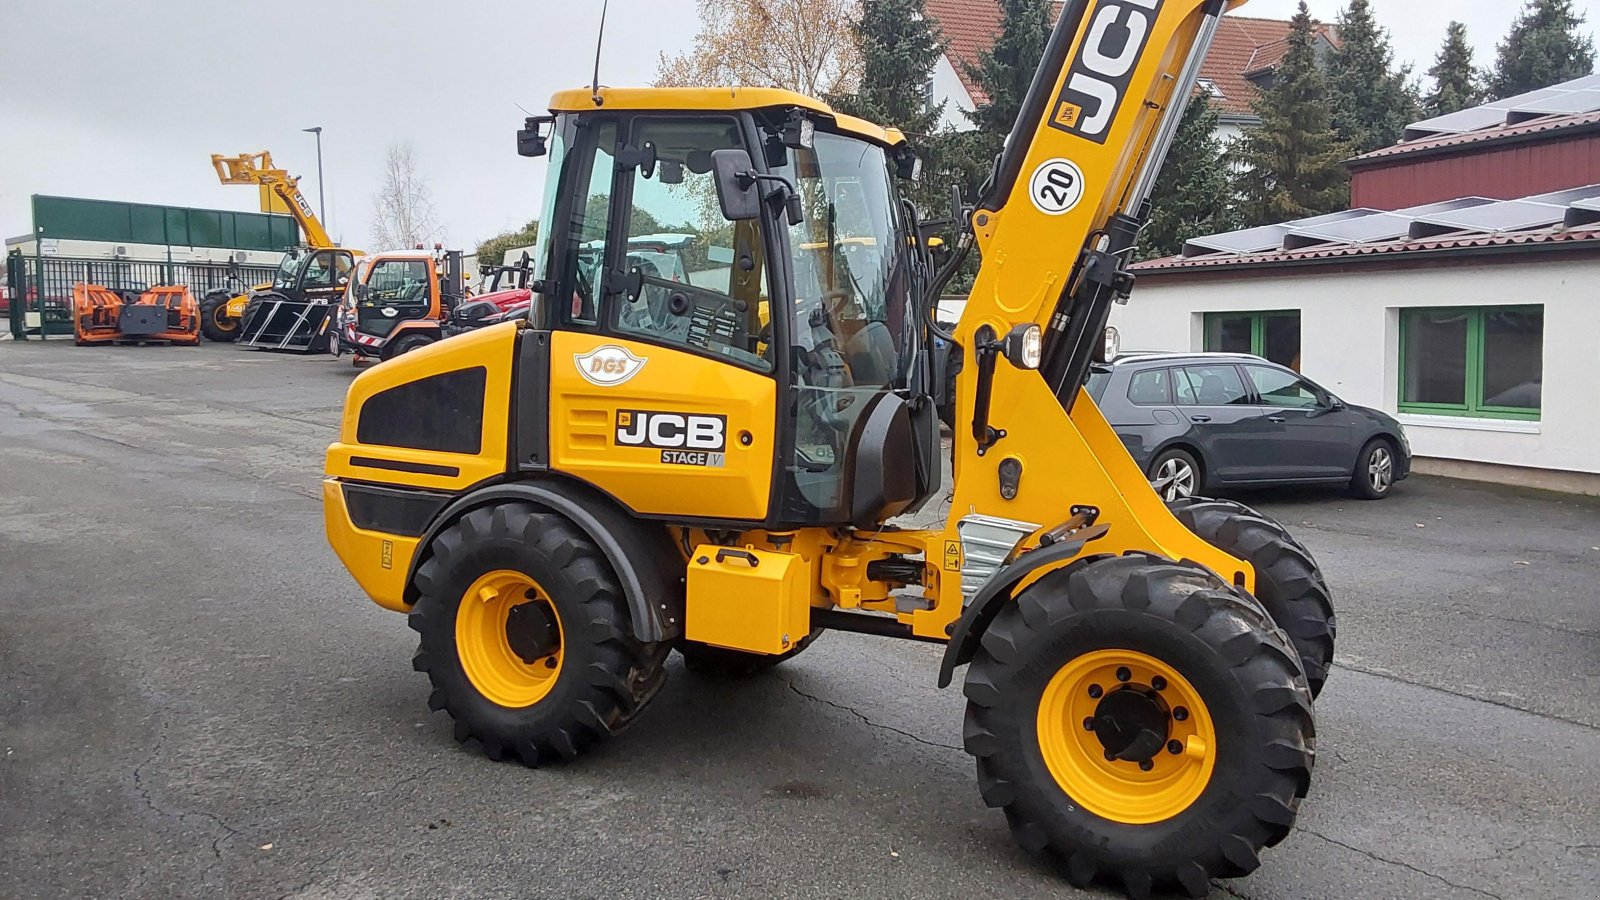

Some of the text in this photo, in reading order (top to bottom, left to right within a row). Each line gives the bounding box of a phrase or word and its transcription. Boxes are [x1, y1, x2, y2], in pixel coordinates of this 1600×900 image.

[1069, 0, 1158, 135] JC
[1041, 168, 1074, 207] 20
[293, 193, 313, 218] JCB
[590, 356, 629, 375] DGS
[617, 412, 724, 450] JCB
[661, 451, 723, 466] STAGE V
